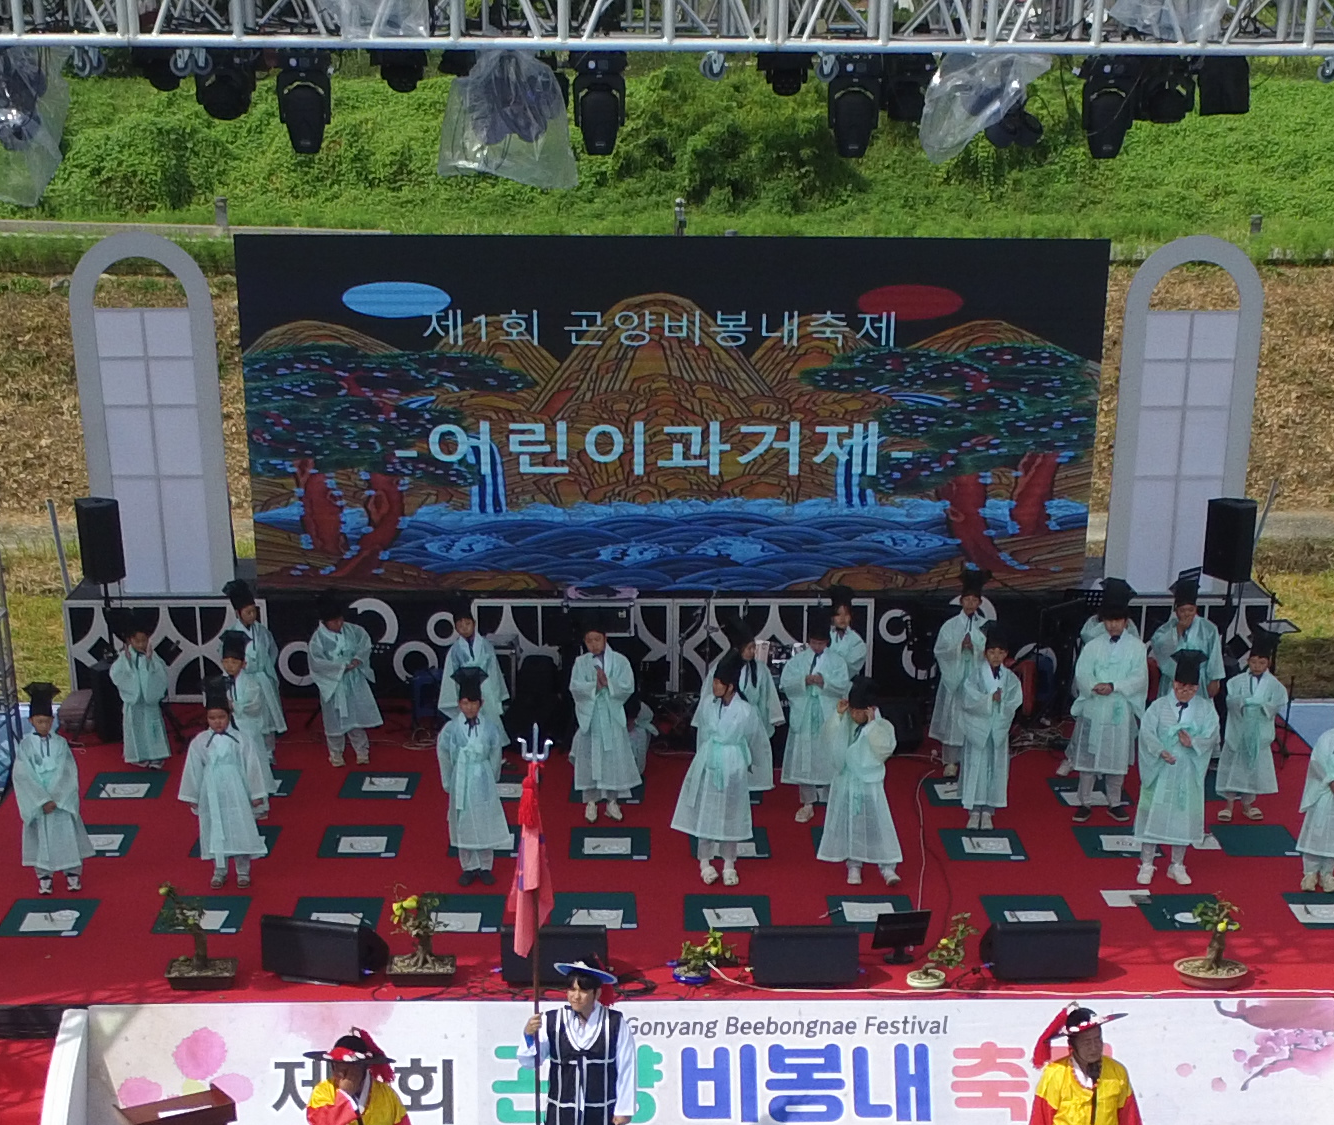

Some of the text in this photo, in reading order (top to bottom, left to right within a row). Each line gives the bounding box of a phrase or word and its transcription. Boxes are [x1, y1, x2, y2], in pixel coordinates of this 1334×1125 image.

[423, 309, 898, 347] 제1회 곤양비봉내축제
[627, 1015, 948, 1038] Gonyang Beebongnae Festival
[272, 1057, 454, 1125] 제회
